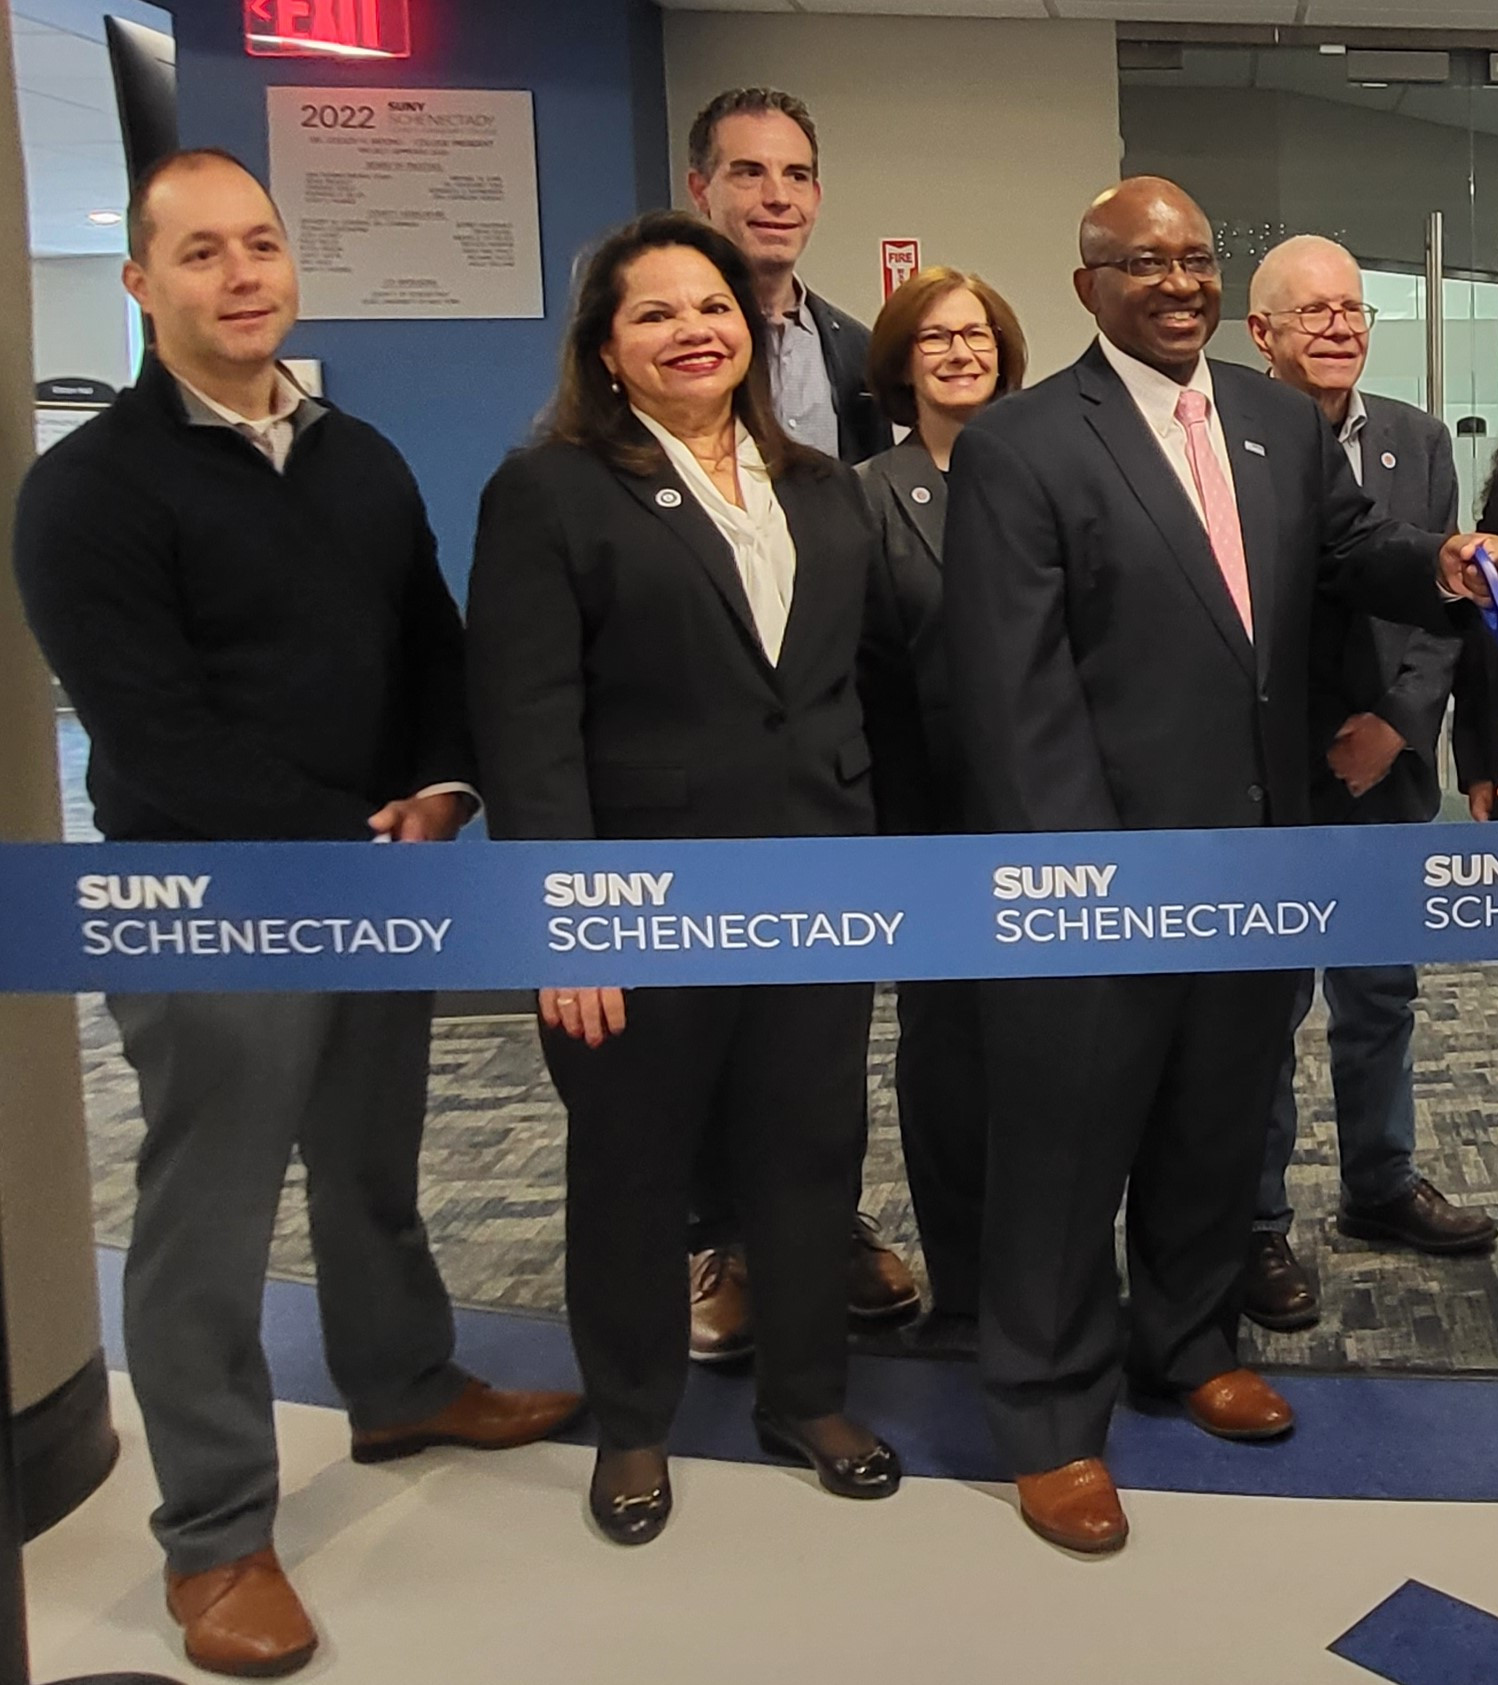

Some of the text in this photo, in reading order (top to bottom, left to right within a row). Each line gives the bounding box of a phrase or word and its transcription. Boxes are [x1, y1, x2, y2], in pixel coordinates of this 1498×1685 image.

[301, 105, 376, 129] 2022
[387, 101, 426, 112] SUNY
[889, 253, 912, 263] FIRE
[78, 875, 211, 909] SUNY
[543, 873, 674, 907] SUNY
[993, 865, 1117, 900] SUNY
[82, 919, 451, 955] SCHENECTADY
[547, 912, 905, 951] SCHENECTADY
[995, 900, 1337, 943] SCHENECTADY
